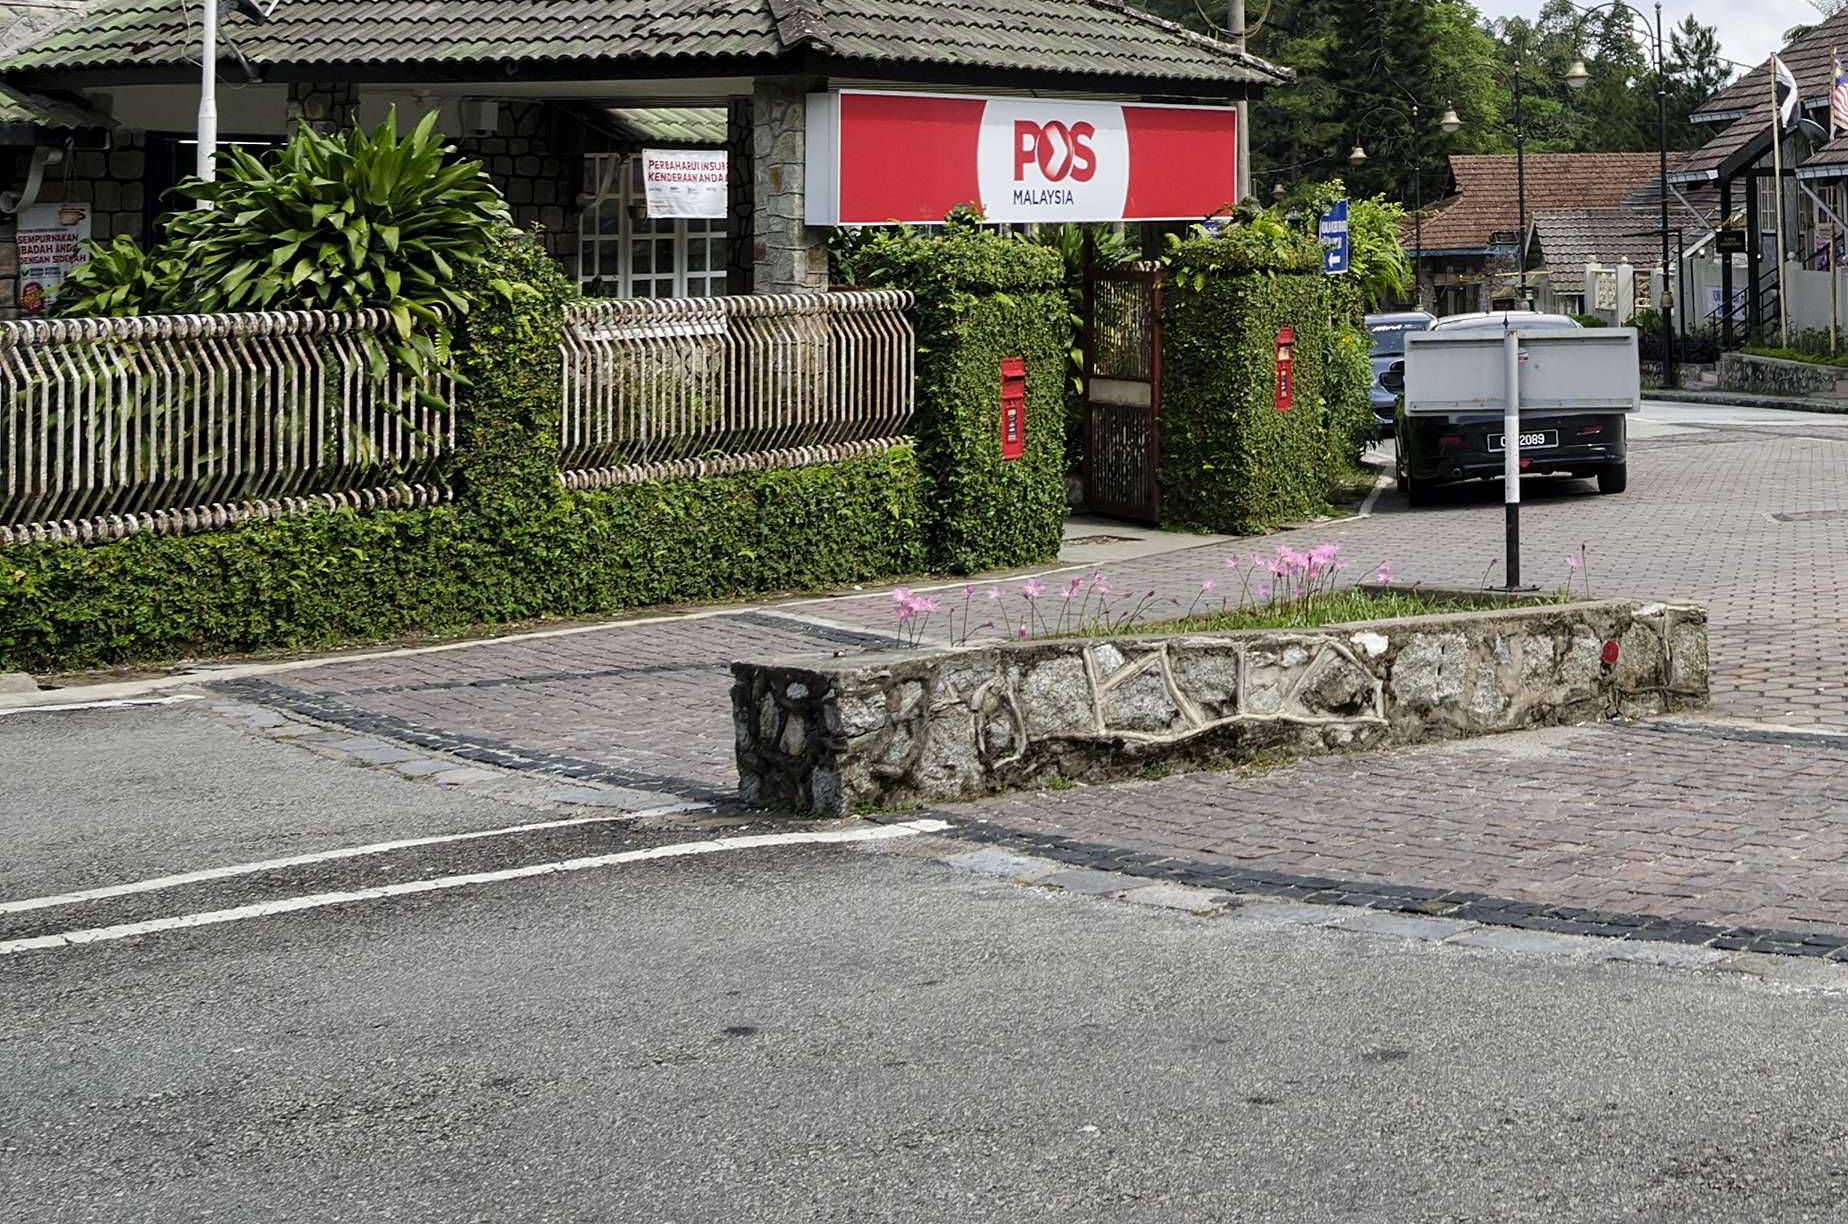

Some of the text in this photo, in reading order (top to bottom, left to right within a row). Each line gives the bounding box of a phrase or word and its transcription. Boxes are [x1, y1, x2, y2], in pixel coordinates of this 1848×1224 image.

[1013, 119, 1097, 183] POS
[648, 159, 728, 171] PERBAHARUI INSUR
[648, 171, 698, 183] KENDERAAN
[1013, 189, 1075, 205] MALAYSIA
[17, 234, 79, 244] SEMPURNAKAN
[1519, 433, 1545, 446] 2089
